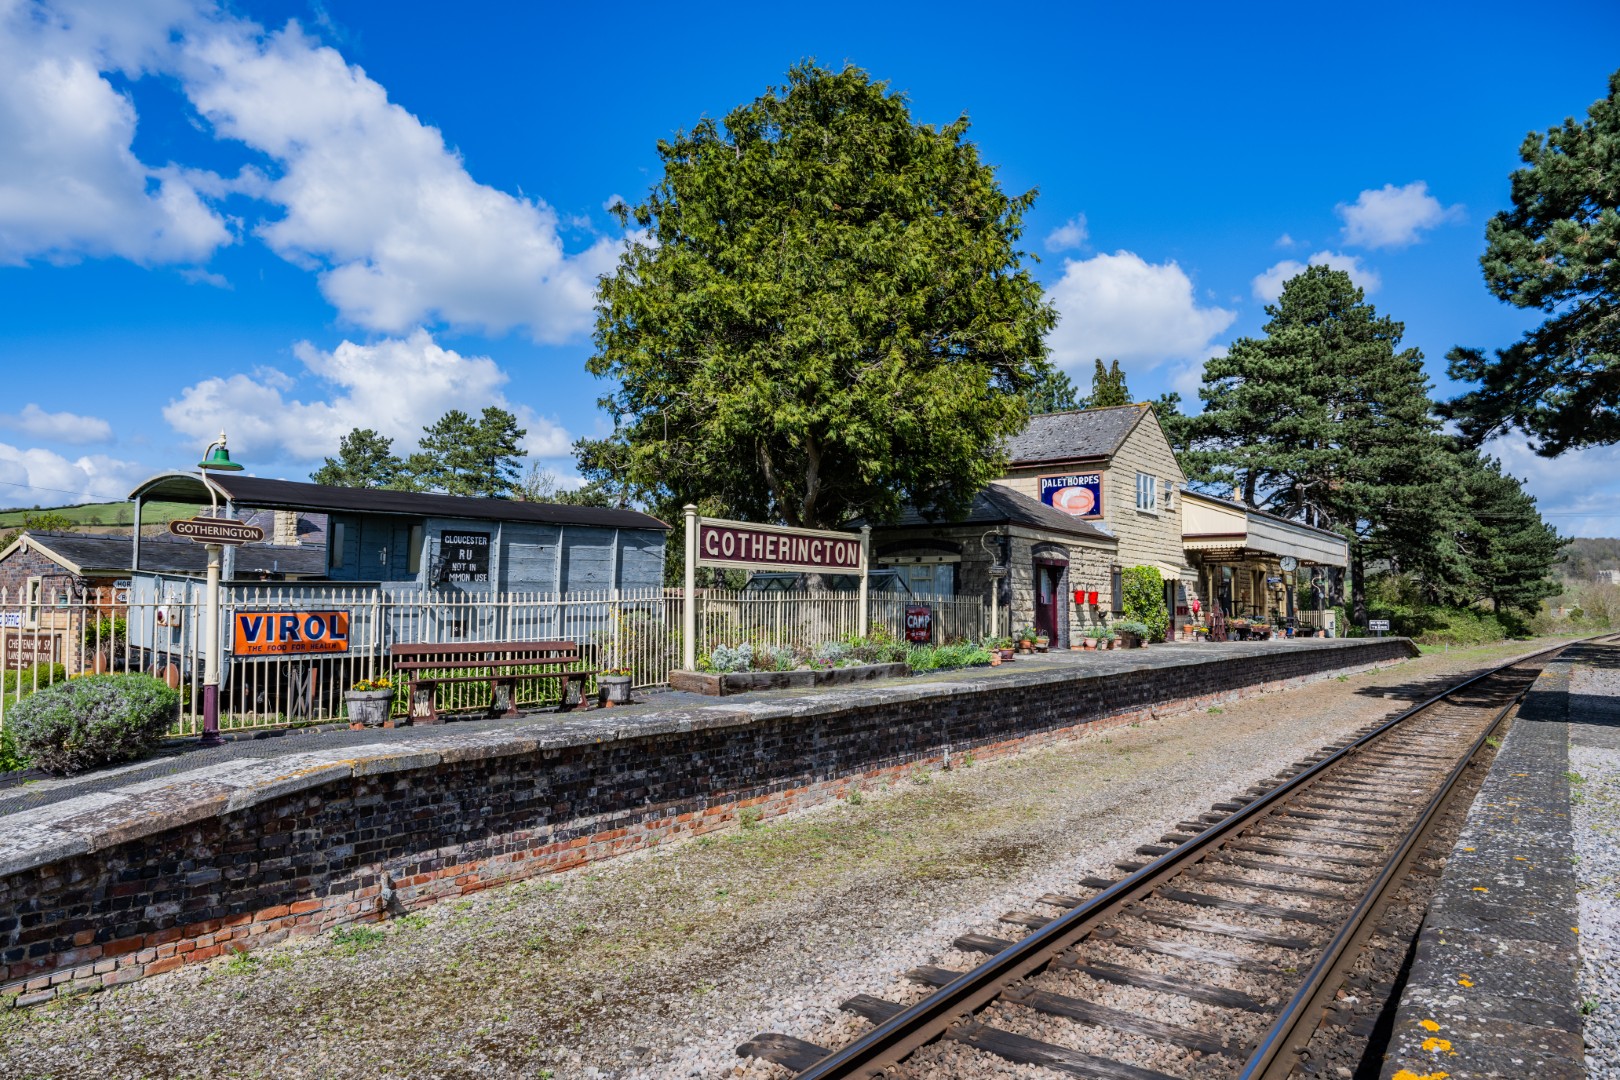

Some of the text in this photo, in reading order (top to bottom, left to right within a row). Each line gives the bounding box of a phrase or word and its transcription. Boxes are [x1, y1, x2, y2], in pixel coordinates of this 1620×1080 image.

[176, 523, 259, 539] GOTHERINGTON
[444, 535, 487, 545] GLOUCESTER
[705, 530, 857, 565] GOTHERINGTON
[452, 563, 466, 571] NOT
[474, 574, 487, 582] USE
[907, 615, 930, 628] CAMP
[240, 615, 347, 643] VIROL
[310, 642, 337, 650] HEALTH
